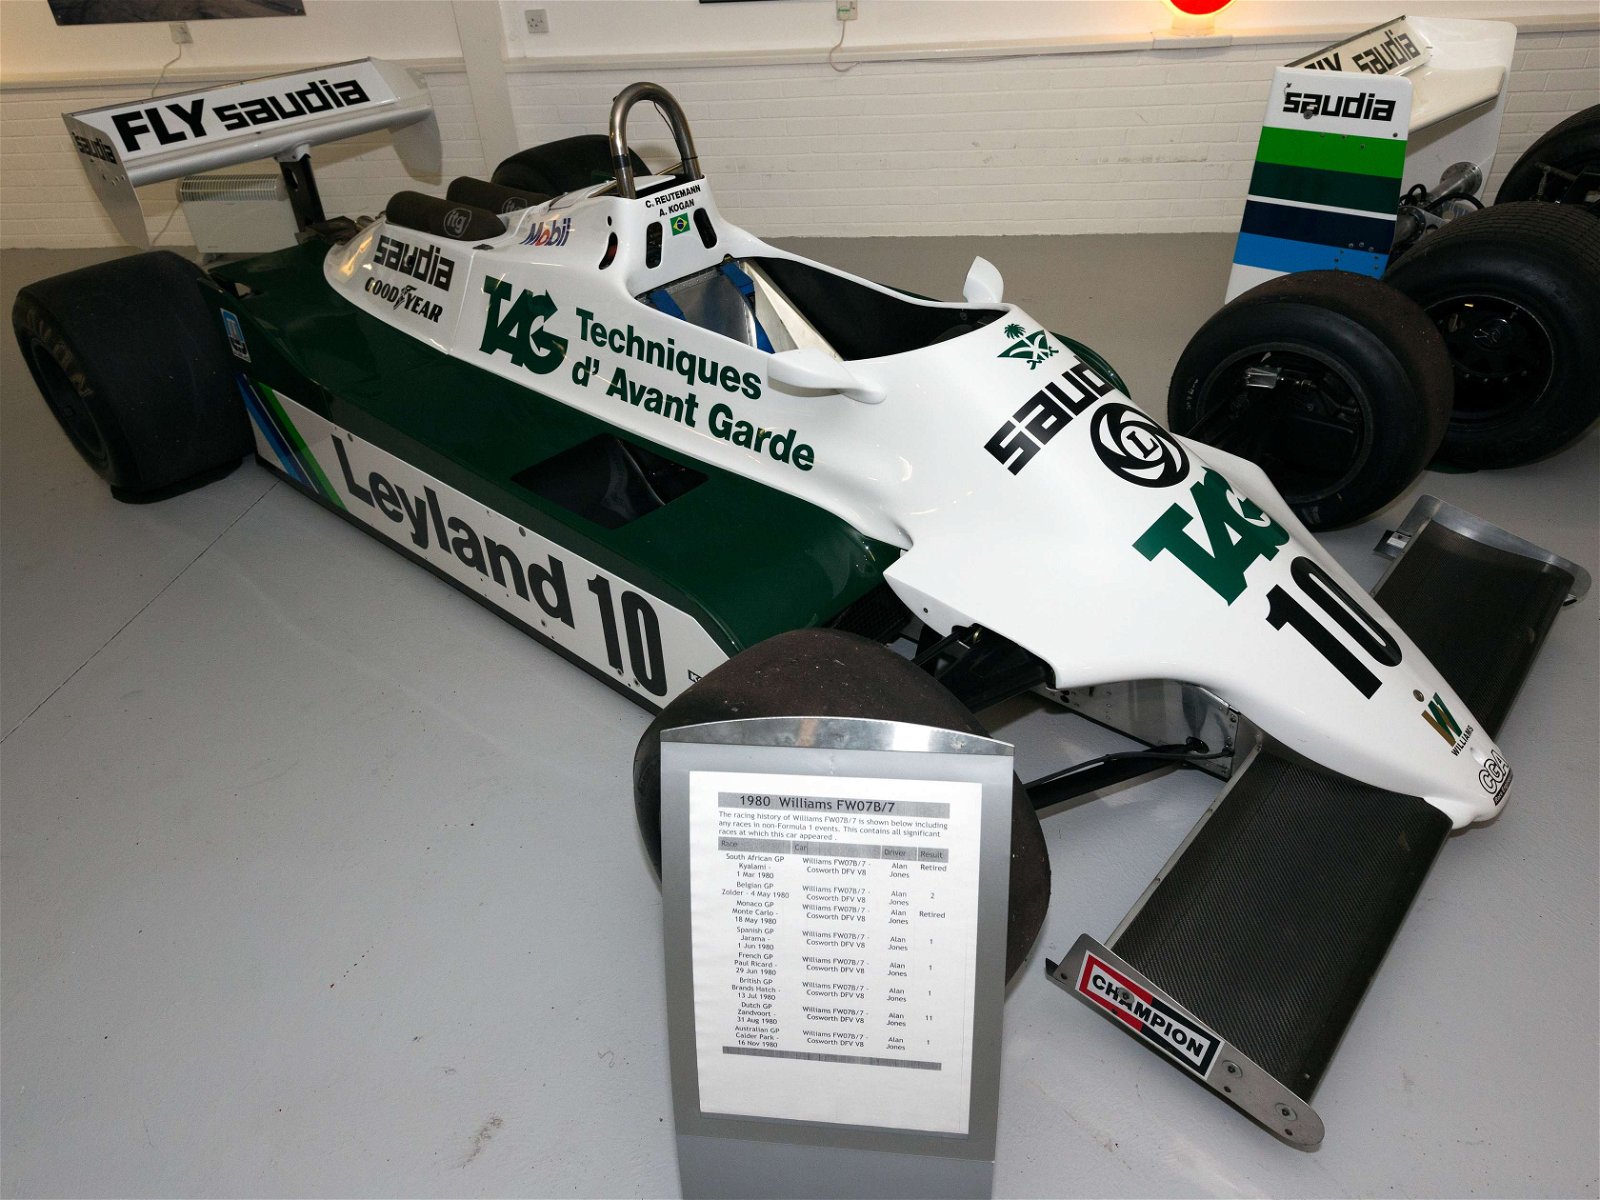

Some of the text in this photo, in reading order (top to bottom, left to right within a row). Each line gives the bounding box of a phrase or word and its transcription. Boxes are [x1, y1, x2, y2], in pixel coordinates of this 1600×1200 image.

[1351, 29, 1421, 75] saudia
[1282, 91, 1396, 122] saudia
[111, 79, 371, 152] FLY saudia
[645, 184, 701, 208] C. REUTEMANN
[659, 198, 695, 217] A. KOGAN
[447, 210, 467, 234] itg
[520, 217, 572, 246] Mobil
[373, 234, 455, 292] saudia
[479, 275, 568, 374] TAG
[576, 307, 761, 400] Techniques
[606, 367, 699, 427] Avant
[708, 403, 815, 471] Garde
[983, 355, 1115, 476] saud
[1132, 466, 1290, 607] TAG
[331, 433, 668, 697] Leyland 10
[1265, 555, 1403, 700] 10
[1451, 724, 1474, 757] WILLIAMS
[1479, 749, 1510, 794] CGA
[740, 795, 896, 813] 1980 Williams FW07B/7
[773, 855, 785, 863] GP
[920, 851, 943, 859] Result
[891, 862, 908, 870] Alan
[920, 863, 948, 873] Retired
[758, 871, 775, 880] 1980
[889, 871, 910, 879] Jones
[763, 882, 774, 890] GP
[773, 891, 790, 899] 1980
[890, 890, 908, 898] Alan
[764, 901, 775, 909] GP
[888, 898, 910, 907] Jones
[890, 909, 907, 917] Alan
[919, 910, 946, 919] Retired
[760, 917, 777, 925] 1980
[888, 917, 909, 926] Jones
[764, 927, 775, 935] GP
[758, 943, 775, 951] 1980
[888, 944, 909, 952] Jones
[763, 953, 774, 961] GP
[889, 962, 906, 970] Alan
[760, 968, 777, 976] 1980
[762, 978, 774, 986] GP
[888, 987, 905, 995] Alan
[759, 993, 777, 1001] 1980
[886, 995, 907, 1003] Jones
[888, 1012, 905, 1020] Alan
[1092, 974, 1203, 1058] CHAMPION
[886, 1020, 907, 1028] Jones
[888, 1036, 904, 1044] Alan
[886, 1043, 906, 1051] Jones
